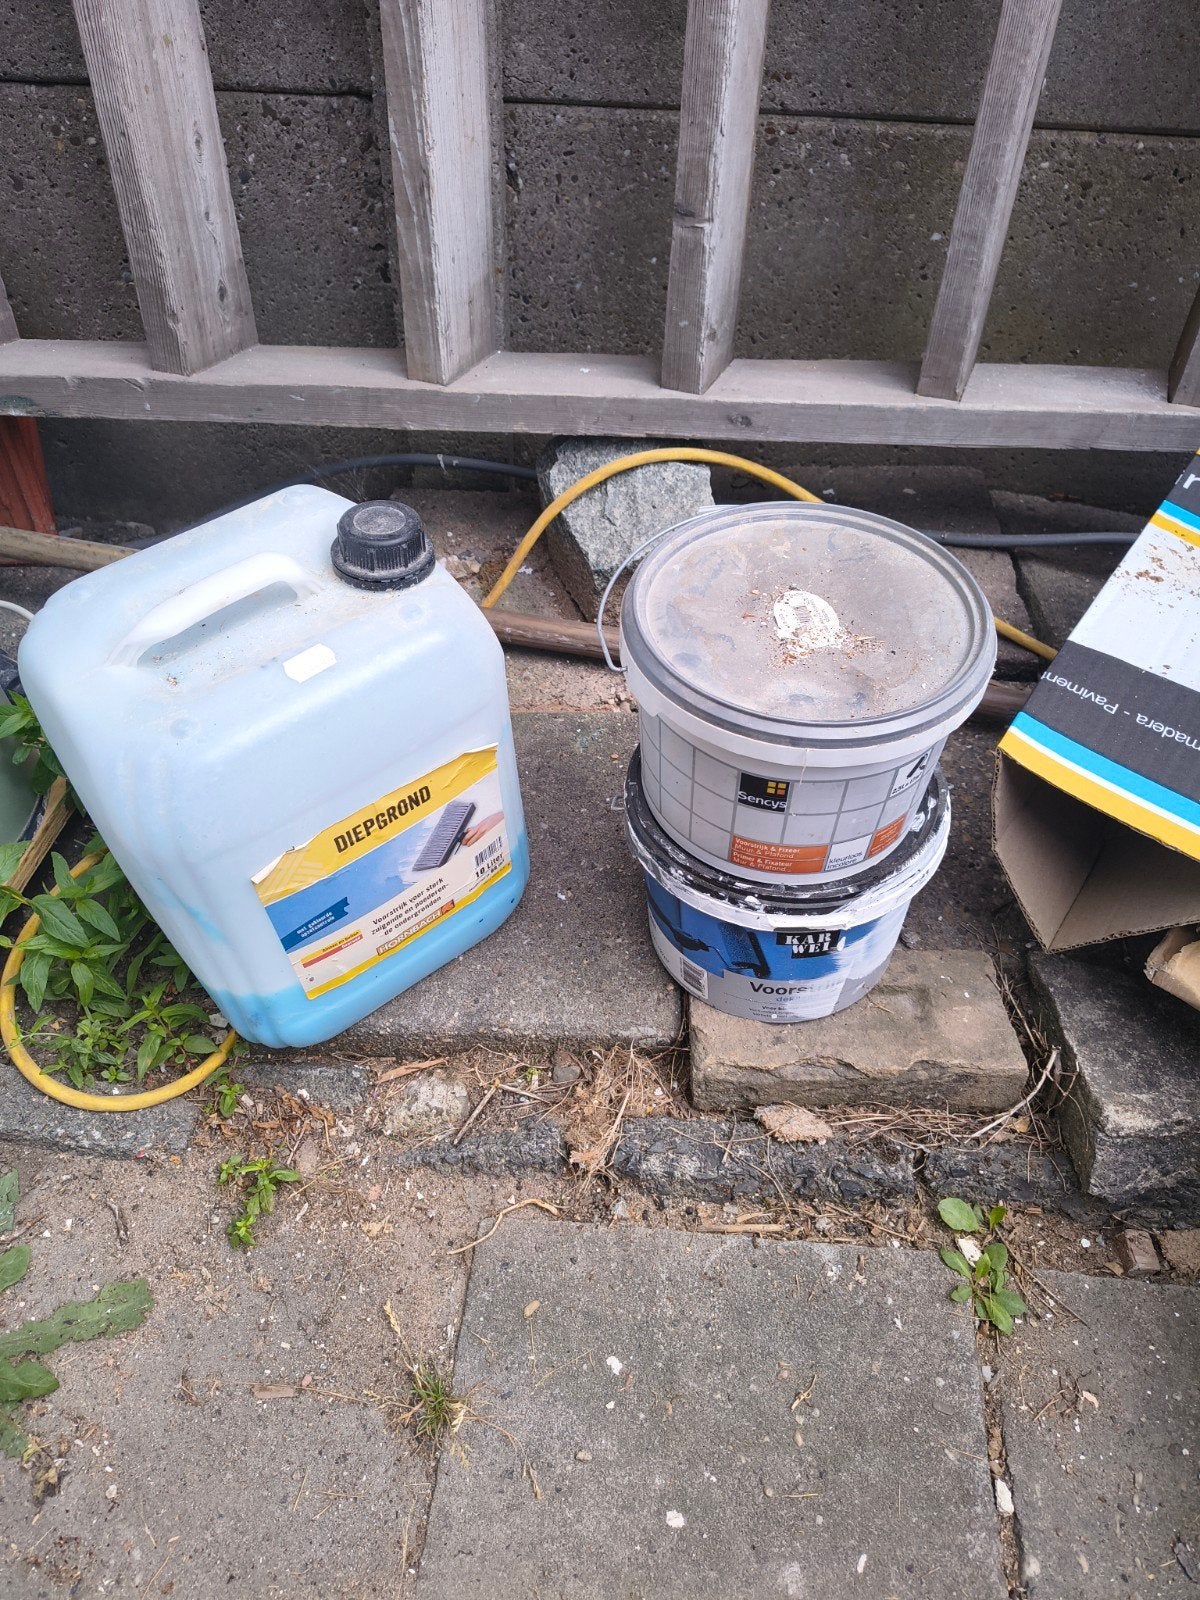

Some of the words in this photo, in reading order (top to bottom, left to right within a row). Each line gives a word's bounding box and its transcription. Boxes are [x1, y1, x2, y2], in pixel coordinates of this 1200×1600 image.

[1136, 713, 1200, 751] madera
[738, 790, 787, 810] Sencys
[333, 785, 432, 854] DIEPGROND
[734, 844, 755, 853] Muur
[764, 851, 795, 859] Plafond
[735, 837, 768, 851] Voorstrijk
[474, 867, 485, 878] 10
[486, 853, 504, 871] Liter
[733, 851, 755, 862] Primer
[764, 858, 793, 867] Fixateur
[828, 851, 863, 866] kleurloos
[757, 863, 786, 872] Plafond
[372, 901, 408, 925] Voorstrijk
[408, 891, 425, 906] voor
[426, 877, 444, 893] sterk
[403, 906, 414, 916] en
[377, 911, 442, 955] HORNBACH
[383, 927, 392, 937] de
[785, 932, 832, 945] KAR
[792, 942, 830, 954] WEI
